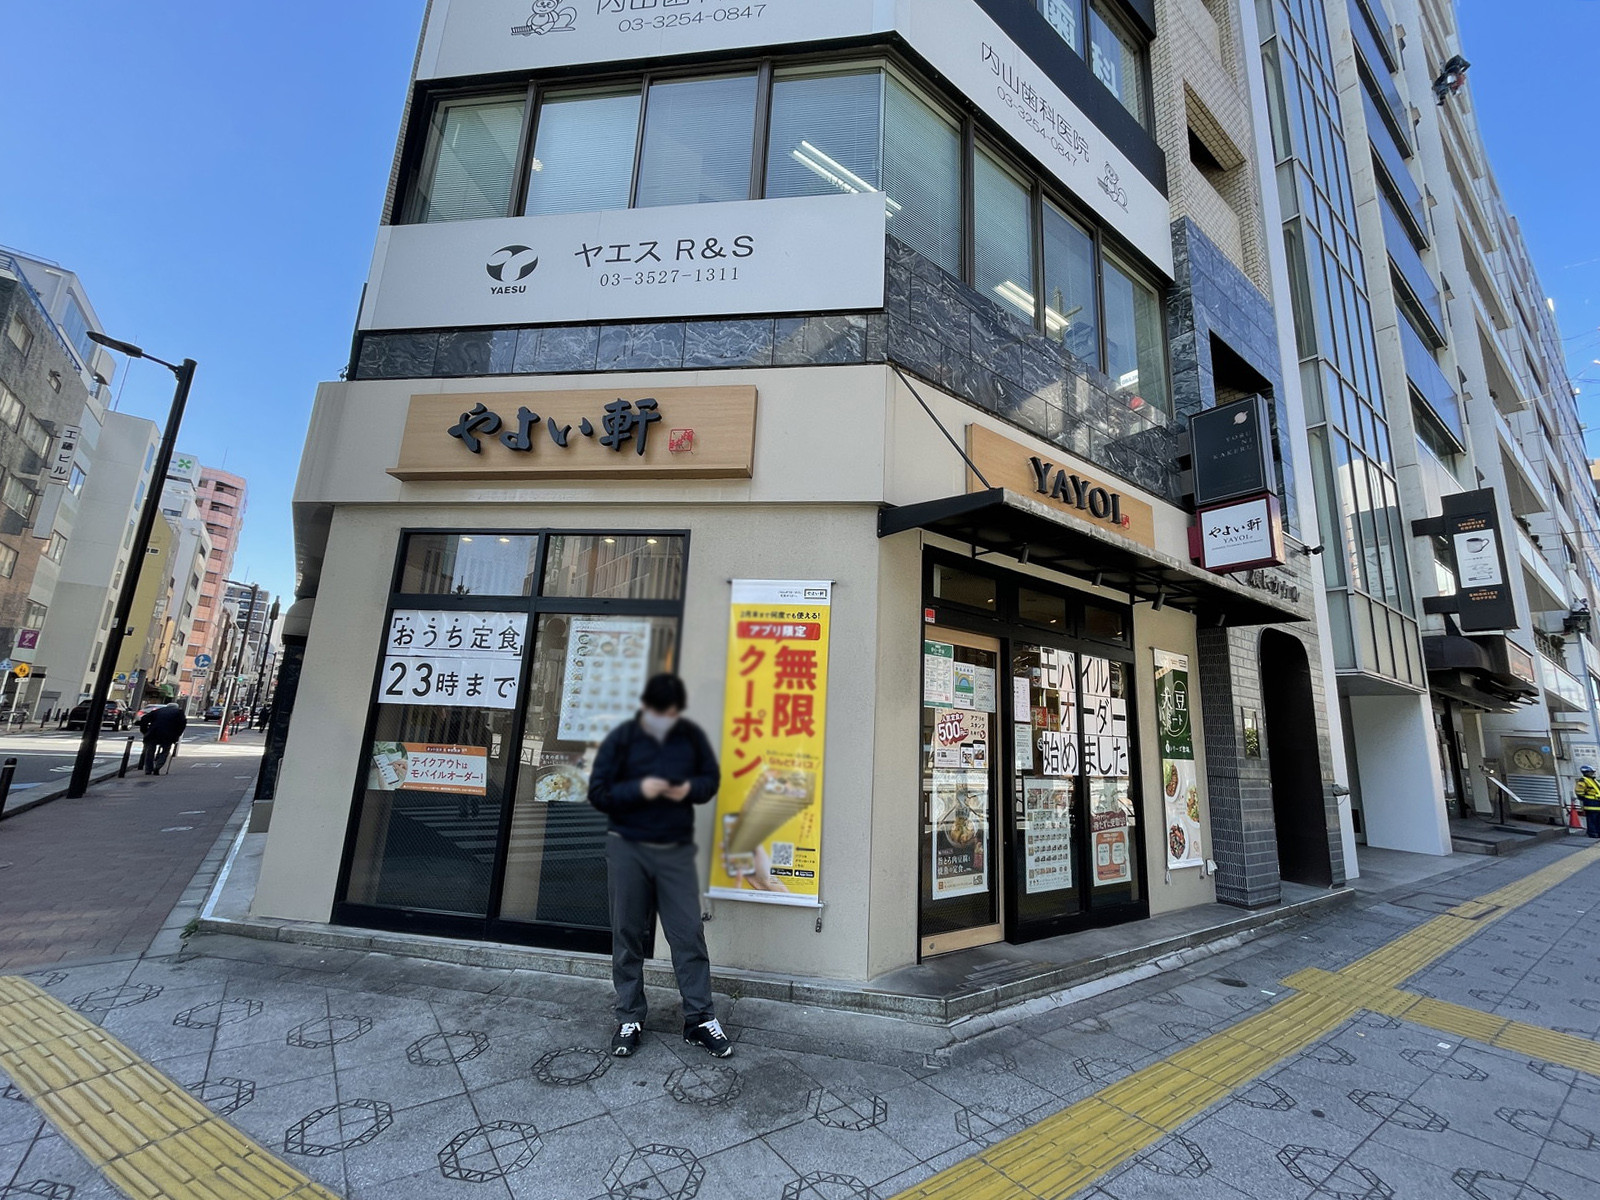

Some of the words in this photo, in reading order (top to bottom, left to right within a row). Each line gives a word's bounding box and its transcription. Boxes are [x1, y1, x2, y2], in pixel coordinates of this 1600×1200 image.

[618, 4, 767, 33] 03-3254-0847
[981, 42, 1089, 163] 内山歯科医院
[997, 86, 1077, 166] 03-3254-0847
[574, 241, 662, 268] ヤエス
[675, 235, 754, 261] R&S
[490, 285, 527, 295] YAESU
[600, 267, 739, 287] 03-3527-1311
[447, 397, 663, 456] やよい軒
[1029, 456, 1122, 525] YAYOI
[1208, 517, 1262, 538] やよい軒
[1222, 534, 1249, 543] YAYOI
[749, 624, 807, 638] アプリ限定
[385, 662, 517, 698] 23時まで
[1041, 647, 1109, 693] モバイル
[771, 645, 818, 738] 無限
[731, 644, 767, 779] クーポン
[1060, 692, 1126, 734] オーダー
[938, 721, 960, 741] 500
[411, 757, 468, 769] テイクアウトは
[1043, 733, 1128, 774] 始めました
[411, 769, 484, 783] モバイルオーダー!
